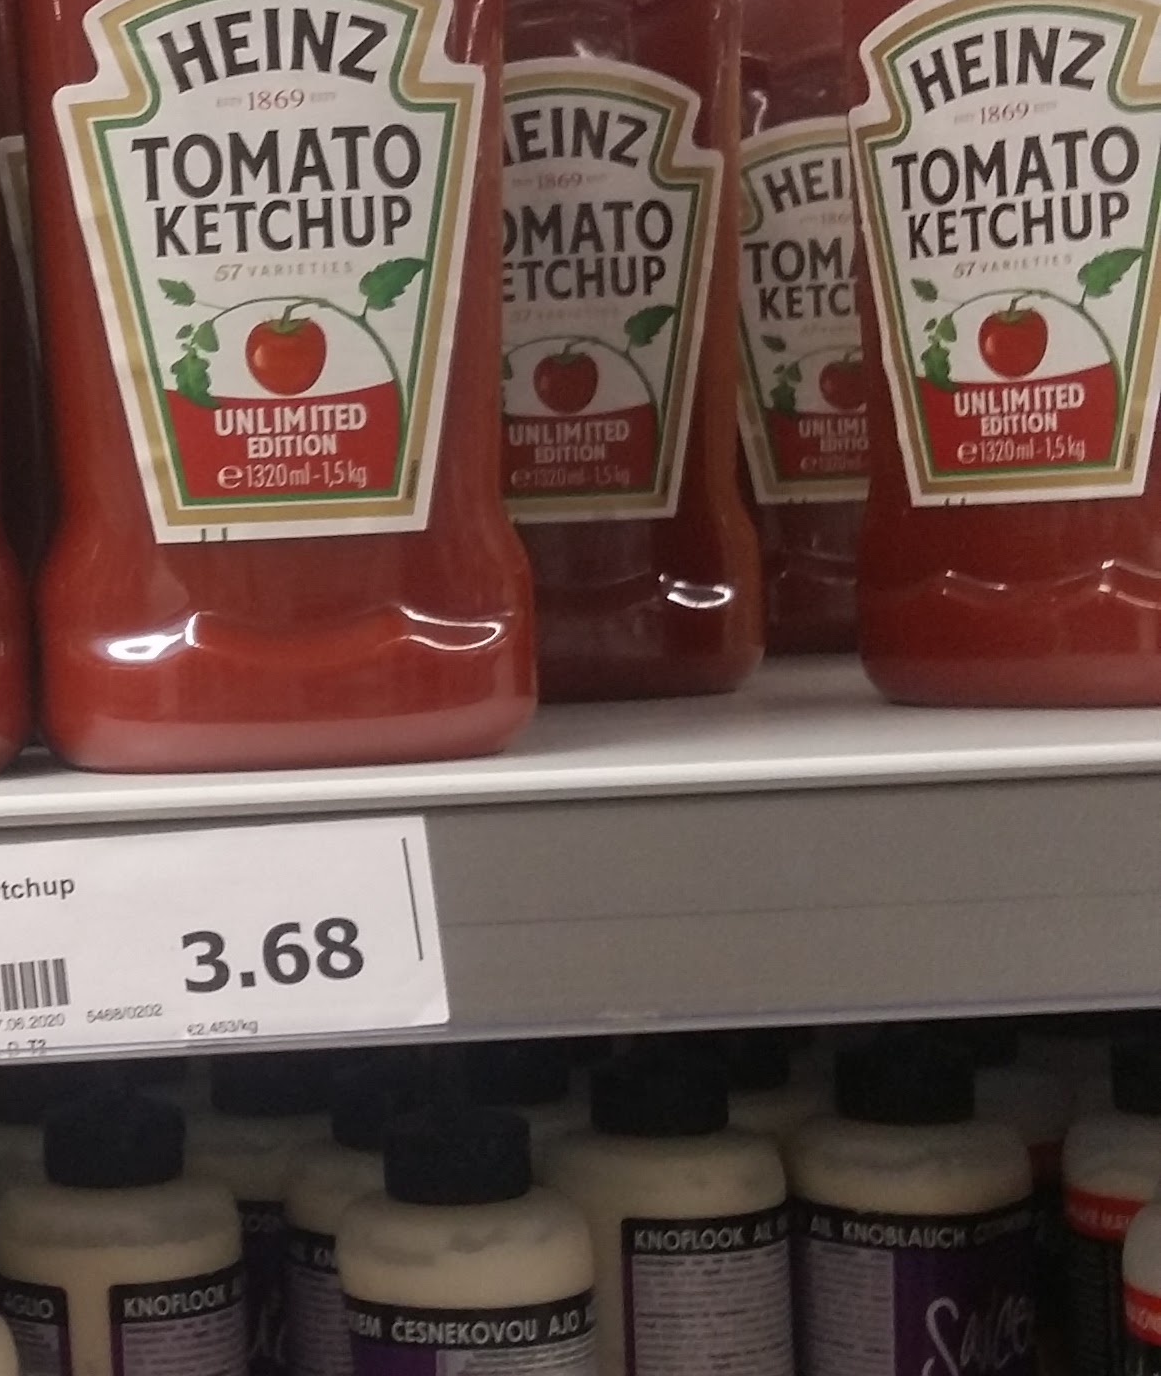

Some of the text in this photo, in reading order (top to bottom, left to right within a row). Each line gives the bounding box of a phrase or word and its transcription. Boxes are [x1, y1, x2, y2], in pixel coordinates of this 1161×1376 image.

[157, 7, 388, 94] HEINZ
[909, 27, 1106, 114] HEINZ
[246, 89, 305, 112] 1869
[979, 102, 1030, 125] 1869
[503, 106, 647, 167] EINZ
[131, 124, 421, 202] TOMATO
[891, 125, 1139, 212] TOMATO
[764, 157, 850, 213] HEI
[154, 195, 413, 257] KETCHUP
[908, 191, 1131, 260] KETCHUP
[503, 255, 667, 303] ETCHUP
[743, 237, 845, 285] TOM
[759, 282, 852, 321] KETC
[954, 382, 1085, 417] UNLIMITED
[214, 402, 367, 436] UNLIMITED
[509, 419, 630, 446] UNLIMITED
[799, 417, 867, 439] UNLIMI
[980, 411, 1058, 437] EDITION
[246, 433, 337, 459] EDITION
[535, 443, 605, 464] EDITION
[820, 436, 869, 452] EDITIO
[180, 917, 365, 994] 3.68
[635, 1226, 743, 1253] KNOFLOOK
[123, 1283, 227, 1320] KNOFLOOK
[548, 1309, 581, 1336] AJO
